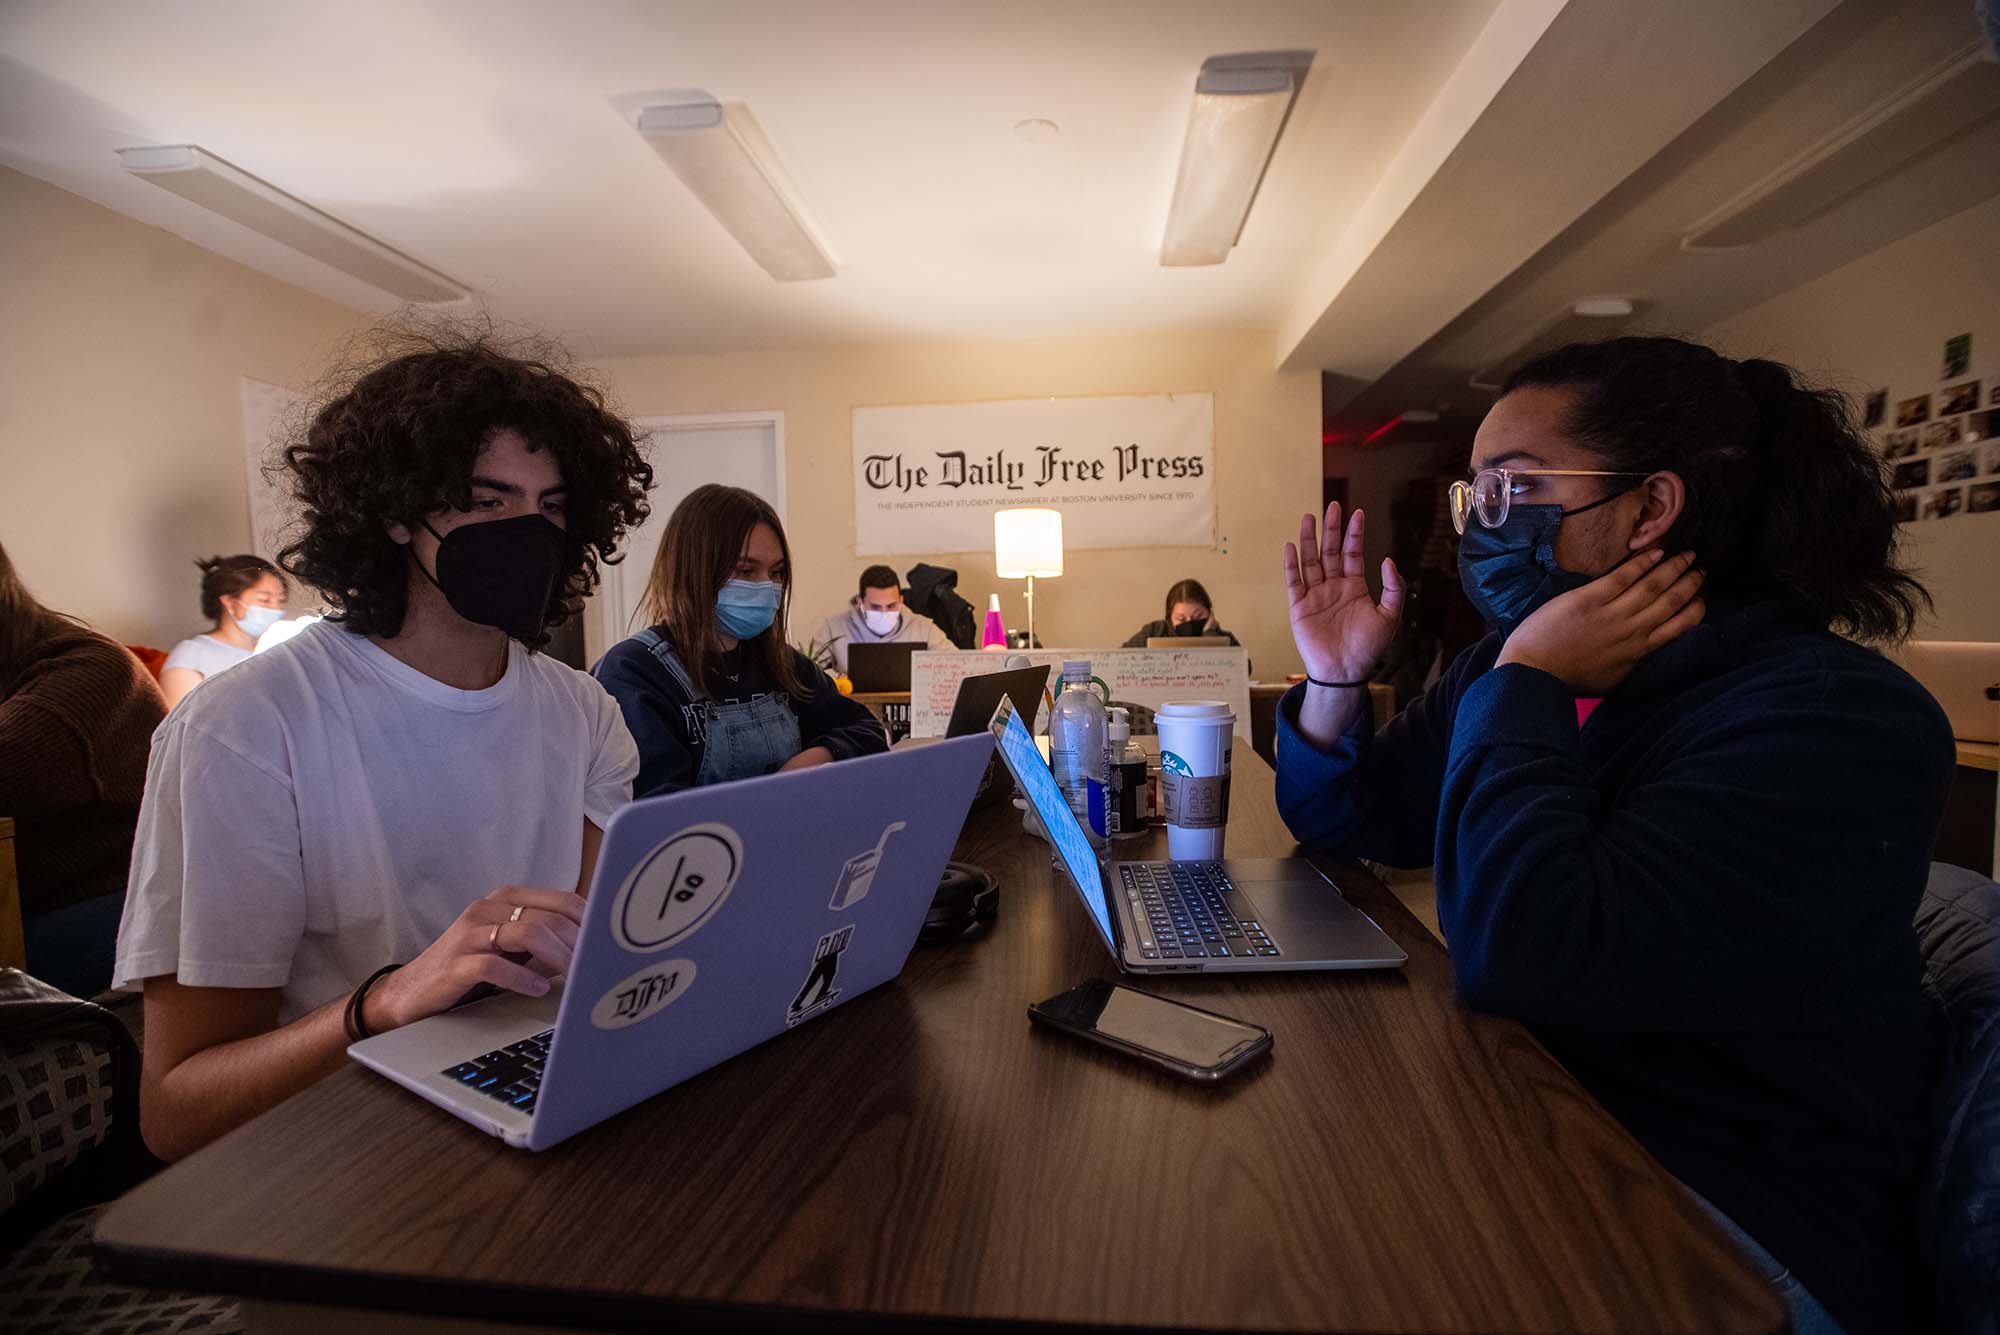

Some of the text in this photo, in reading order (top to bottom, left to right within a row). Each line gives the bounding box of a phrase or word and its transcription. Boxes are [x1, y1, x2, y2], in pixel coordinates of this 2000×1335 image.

[862, 443, 1204, 493] The Daily Free Press
[878, 502, 891, 510] THE
[895, 500, 953, 510] INDEPENDENT
[956, 498, 993, 508] STUDENT
[995, 496, 1048, 505] NEWSPAPER
[1062, 495, 1096, 503] BOSTON
[1098, 493, 1147, 502] UNIVERSITY
[1149, 492, 1172, 501] SINCE
